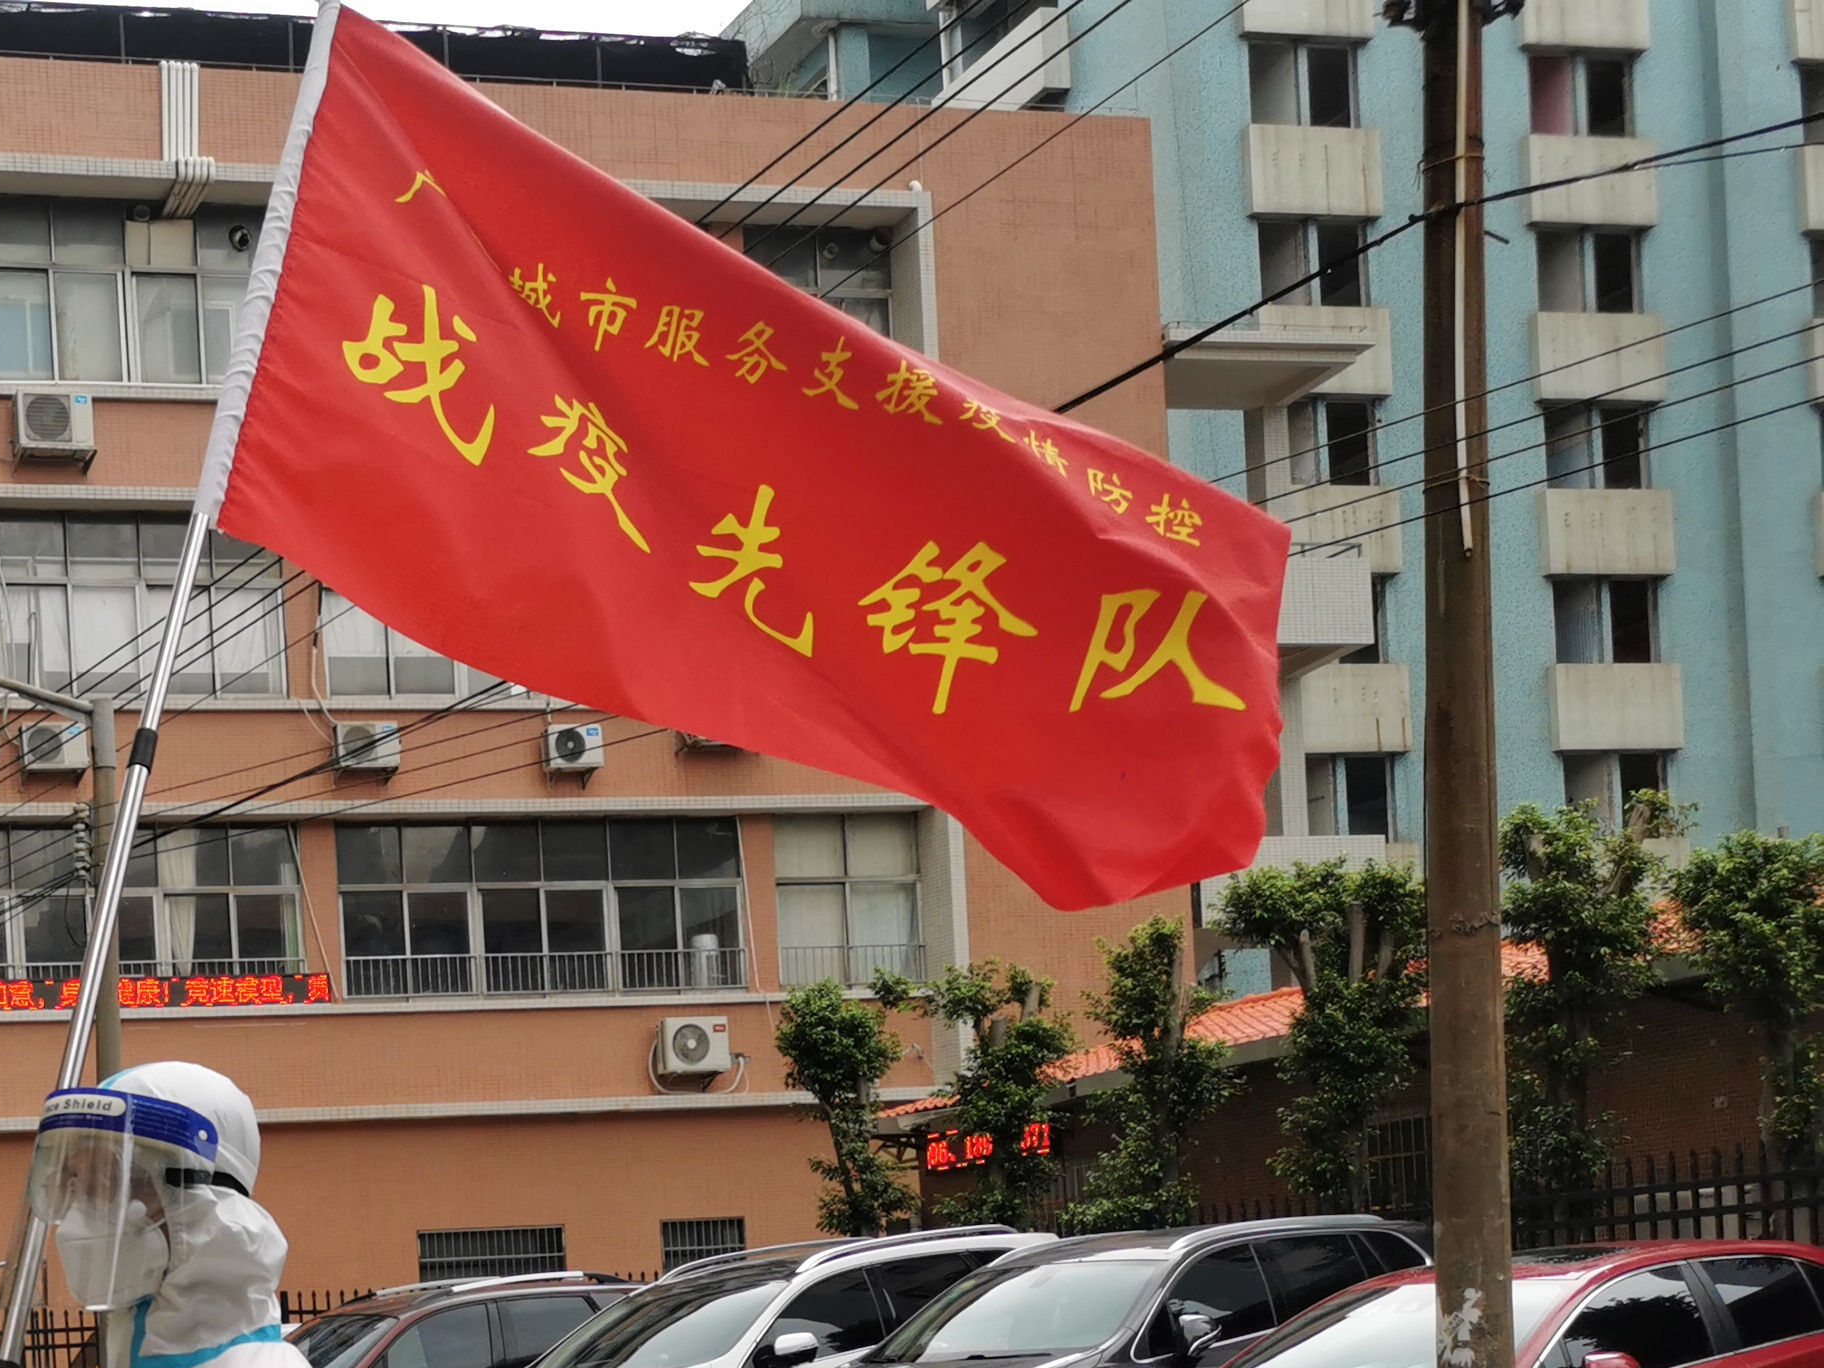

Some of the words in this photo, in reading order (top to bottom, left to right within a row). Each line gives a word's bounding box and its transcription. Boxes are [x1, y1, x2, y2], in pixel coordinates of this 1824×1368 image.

[342, 284, 1247, 714] 战疫先锋队
[395, 169, 1202, 547] 广城市服务支援疫情防控
[63, 1098, 113, 1112] Shield
